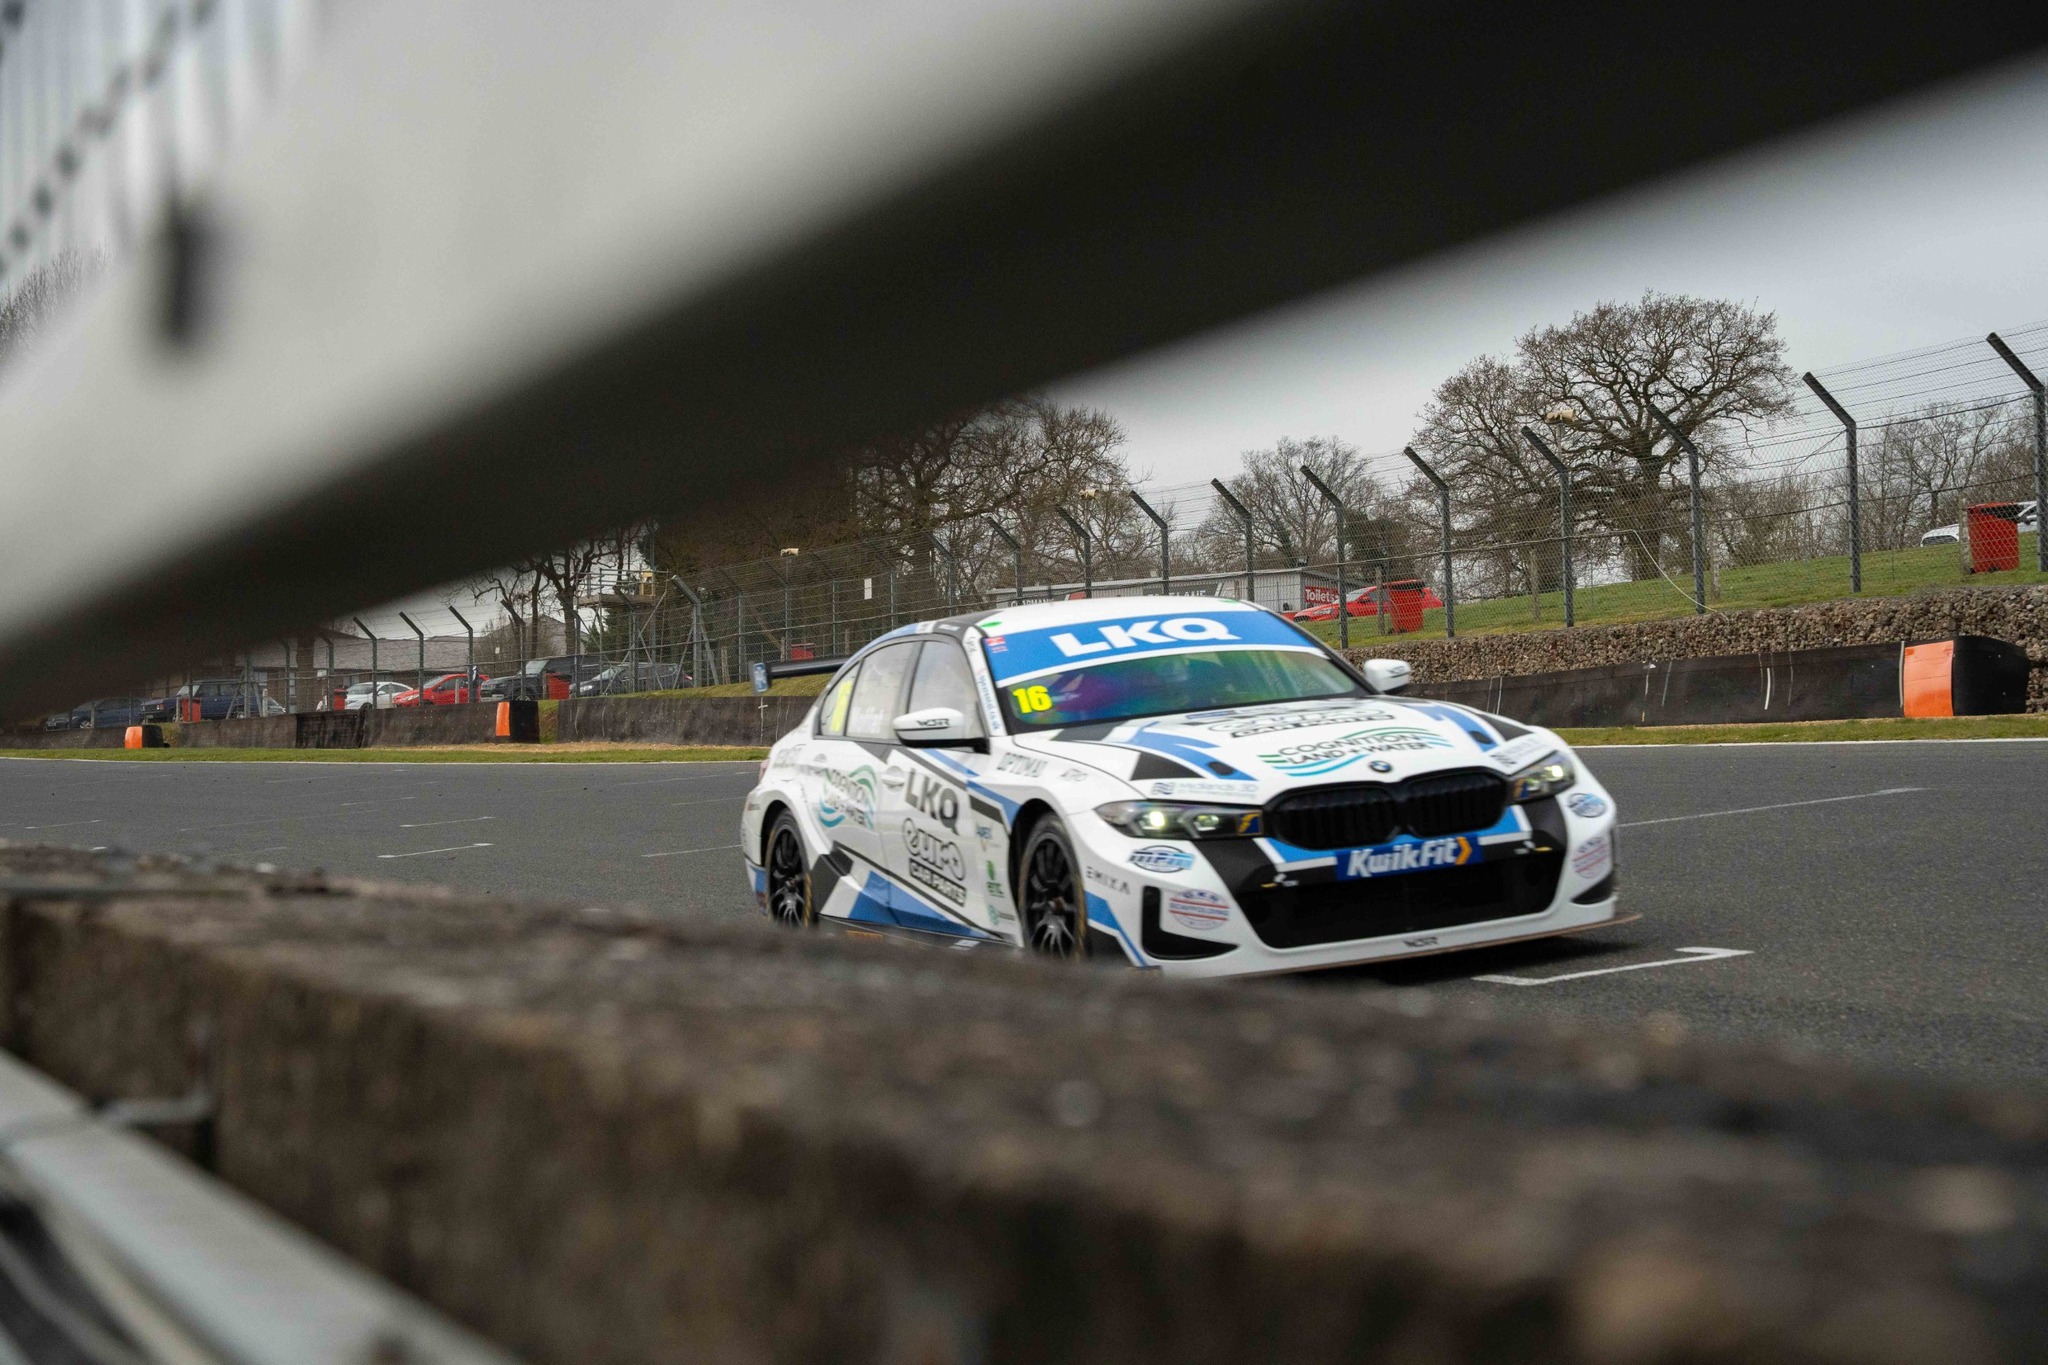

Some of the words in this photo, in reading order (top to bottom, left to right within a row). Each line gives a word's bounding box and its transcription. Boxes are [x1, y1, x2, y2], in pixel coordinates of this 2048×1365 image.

[1049, 617, 1243, 658] LKQ
[1012, 685, 1053, 714] 16
[1279, 734, 1420, 756] COGNITION
[1288, 749, 1345, 764] LAND
[1366, 741, 1432, 753] WATER
[905, 767, 960, 836] LKQ
[901, 817, 966, 882] euro
